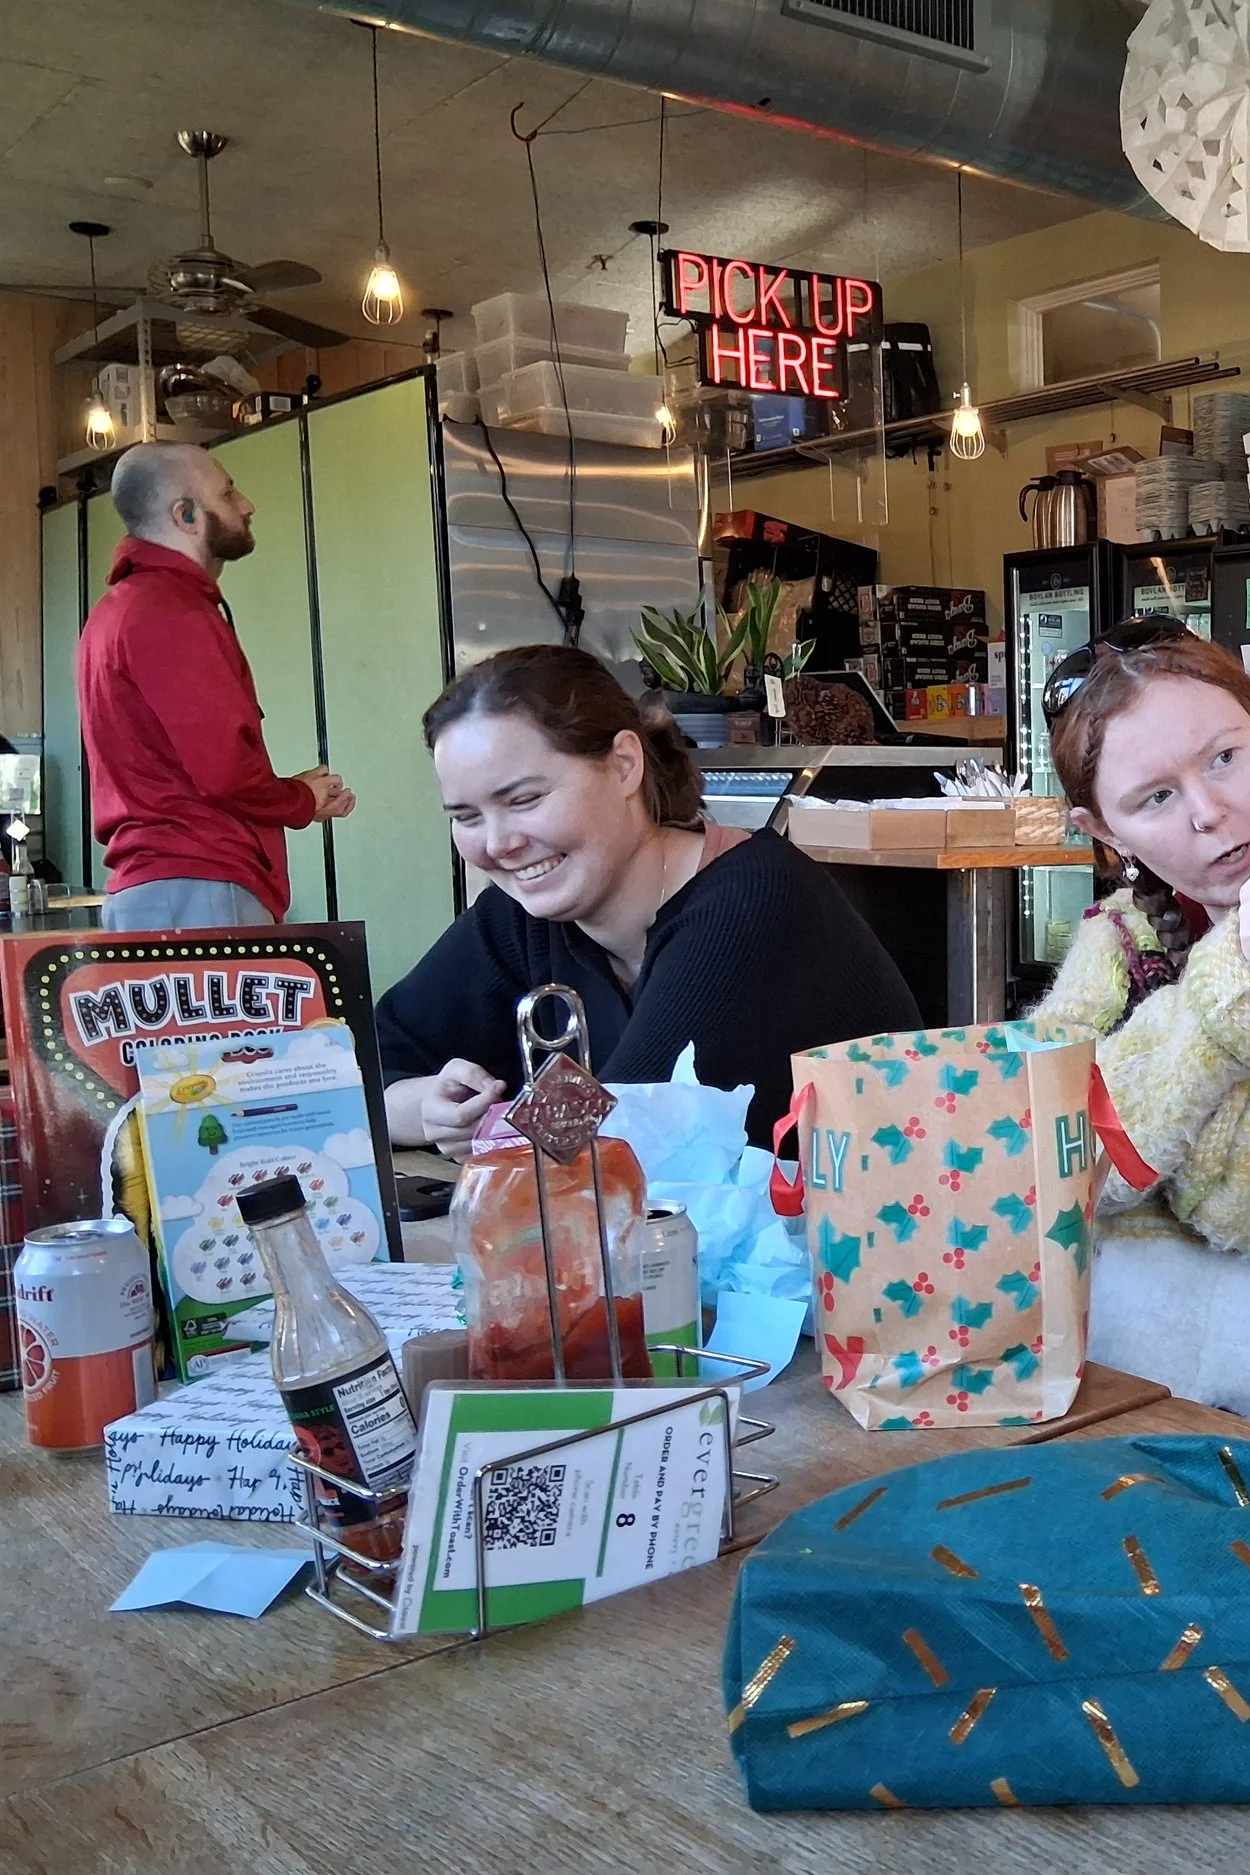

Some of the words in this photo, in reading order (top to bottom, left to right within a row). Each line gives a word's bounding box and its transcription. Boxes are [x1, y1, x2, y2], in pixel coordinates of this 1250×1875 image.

[677, 252, 793, 329] PICK
[811, 272, 874, 338] UP
[711, 322, 840, 398] HERE
[69, 970, 317, 1048] MULLET
[310, 1403, 336, 1418] STYLE
[350, 1411, 392, 1436] Calories
[159, 1425, 221, 1458] Happy
[658, 1426, 675, 1463] ORDER
[570, 1468, 584, 1499] phone
[582, 1479, 595, 1502] Scan
[618, 1461, 634, 1500] Number
[655, 1465, 667, 1488] AND
[578, 1505, 590, 1526] with
[653, 1490, 664, 1512] PAY
[442, 1465, 470, 1580] OrderWithToast.com
[463, 1509, 476, 1540] scan?
[565, 1502, 577, 1538] camera
[615, 1513, 636, 1528] 8
[651, 1514, 660, 1529] BY
[645, 1531, 659, 1570] PHONE
[405, 1585, 414, 1597] by
